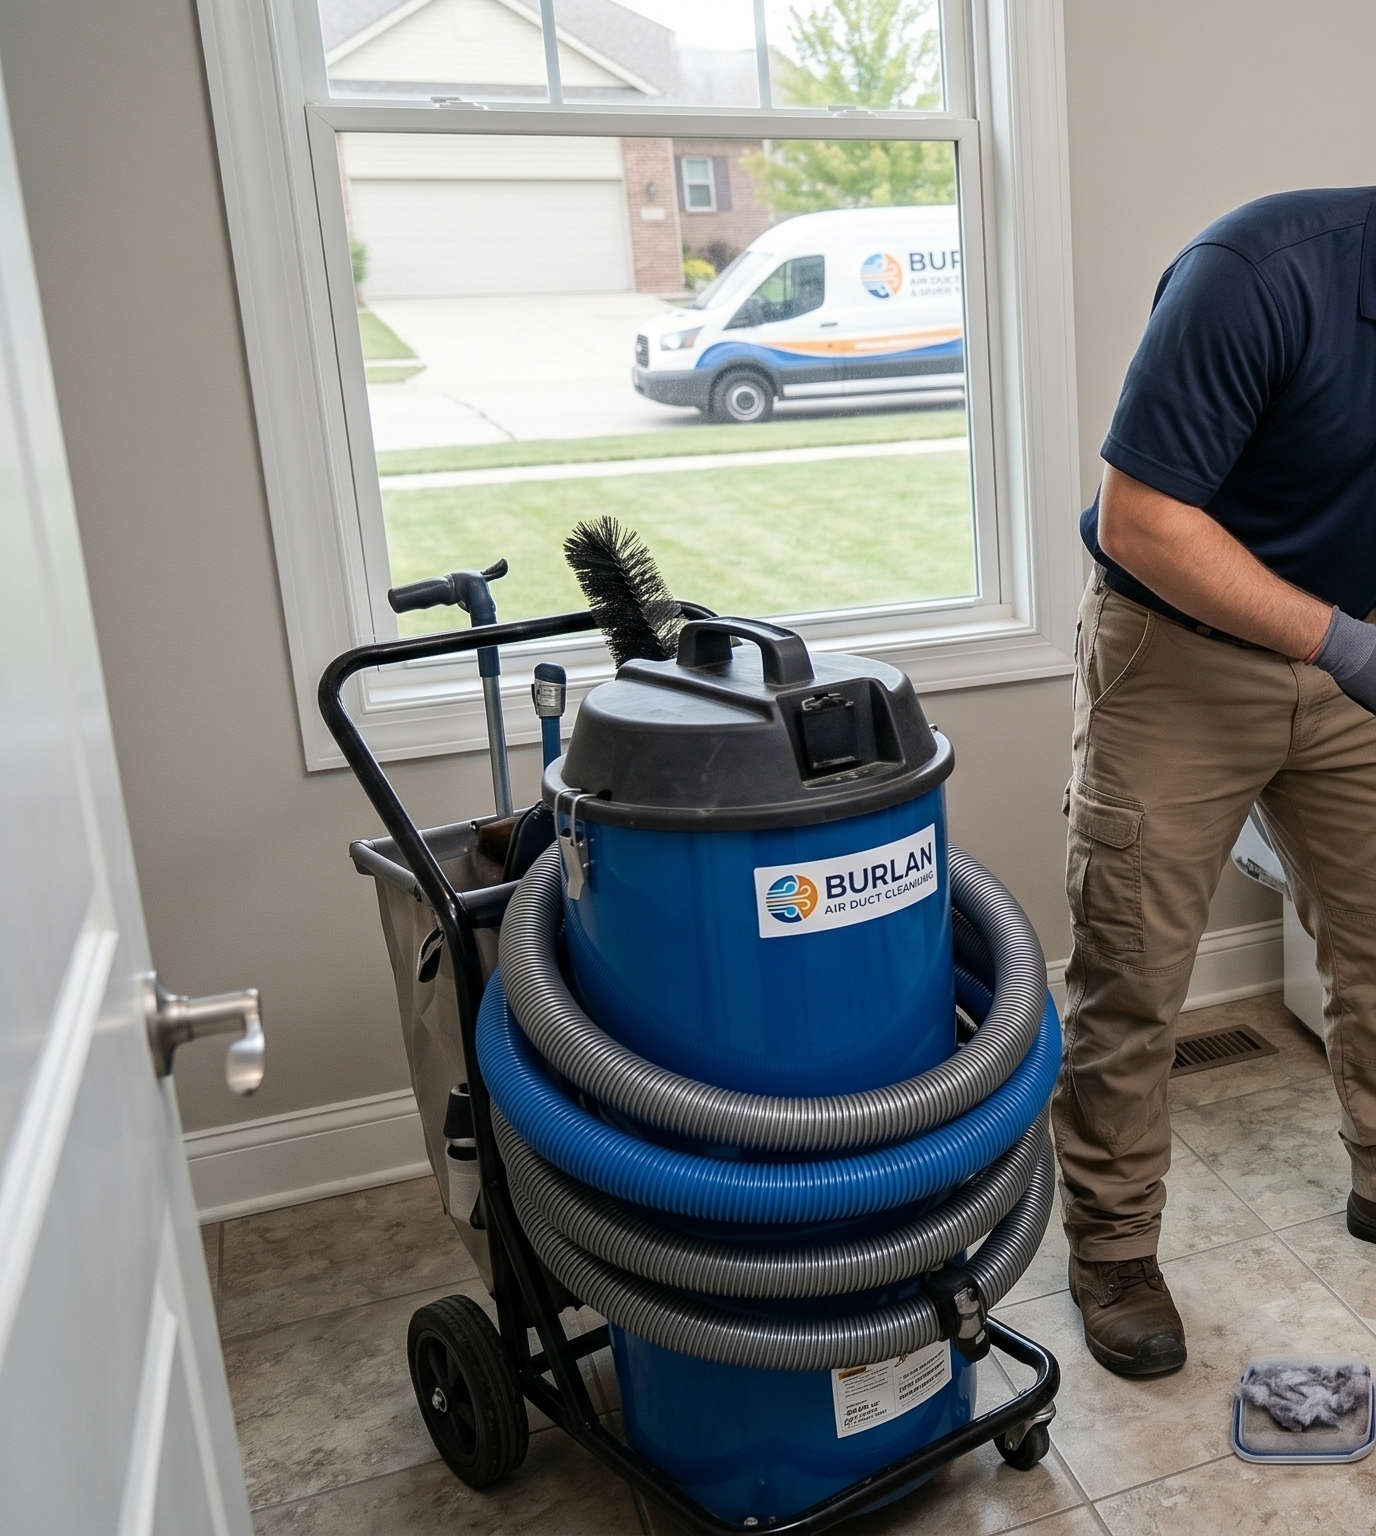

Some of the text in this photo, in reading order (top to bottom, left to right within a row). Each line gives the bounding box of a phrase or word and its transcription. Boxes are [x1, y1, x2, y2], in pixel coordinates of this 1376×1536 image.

[825, 842, 932, 900] BURLAN
[824, 902, 846, 915] AIR
[850, 892, 882, 910] DUCT
